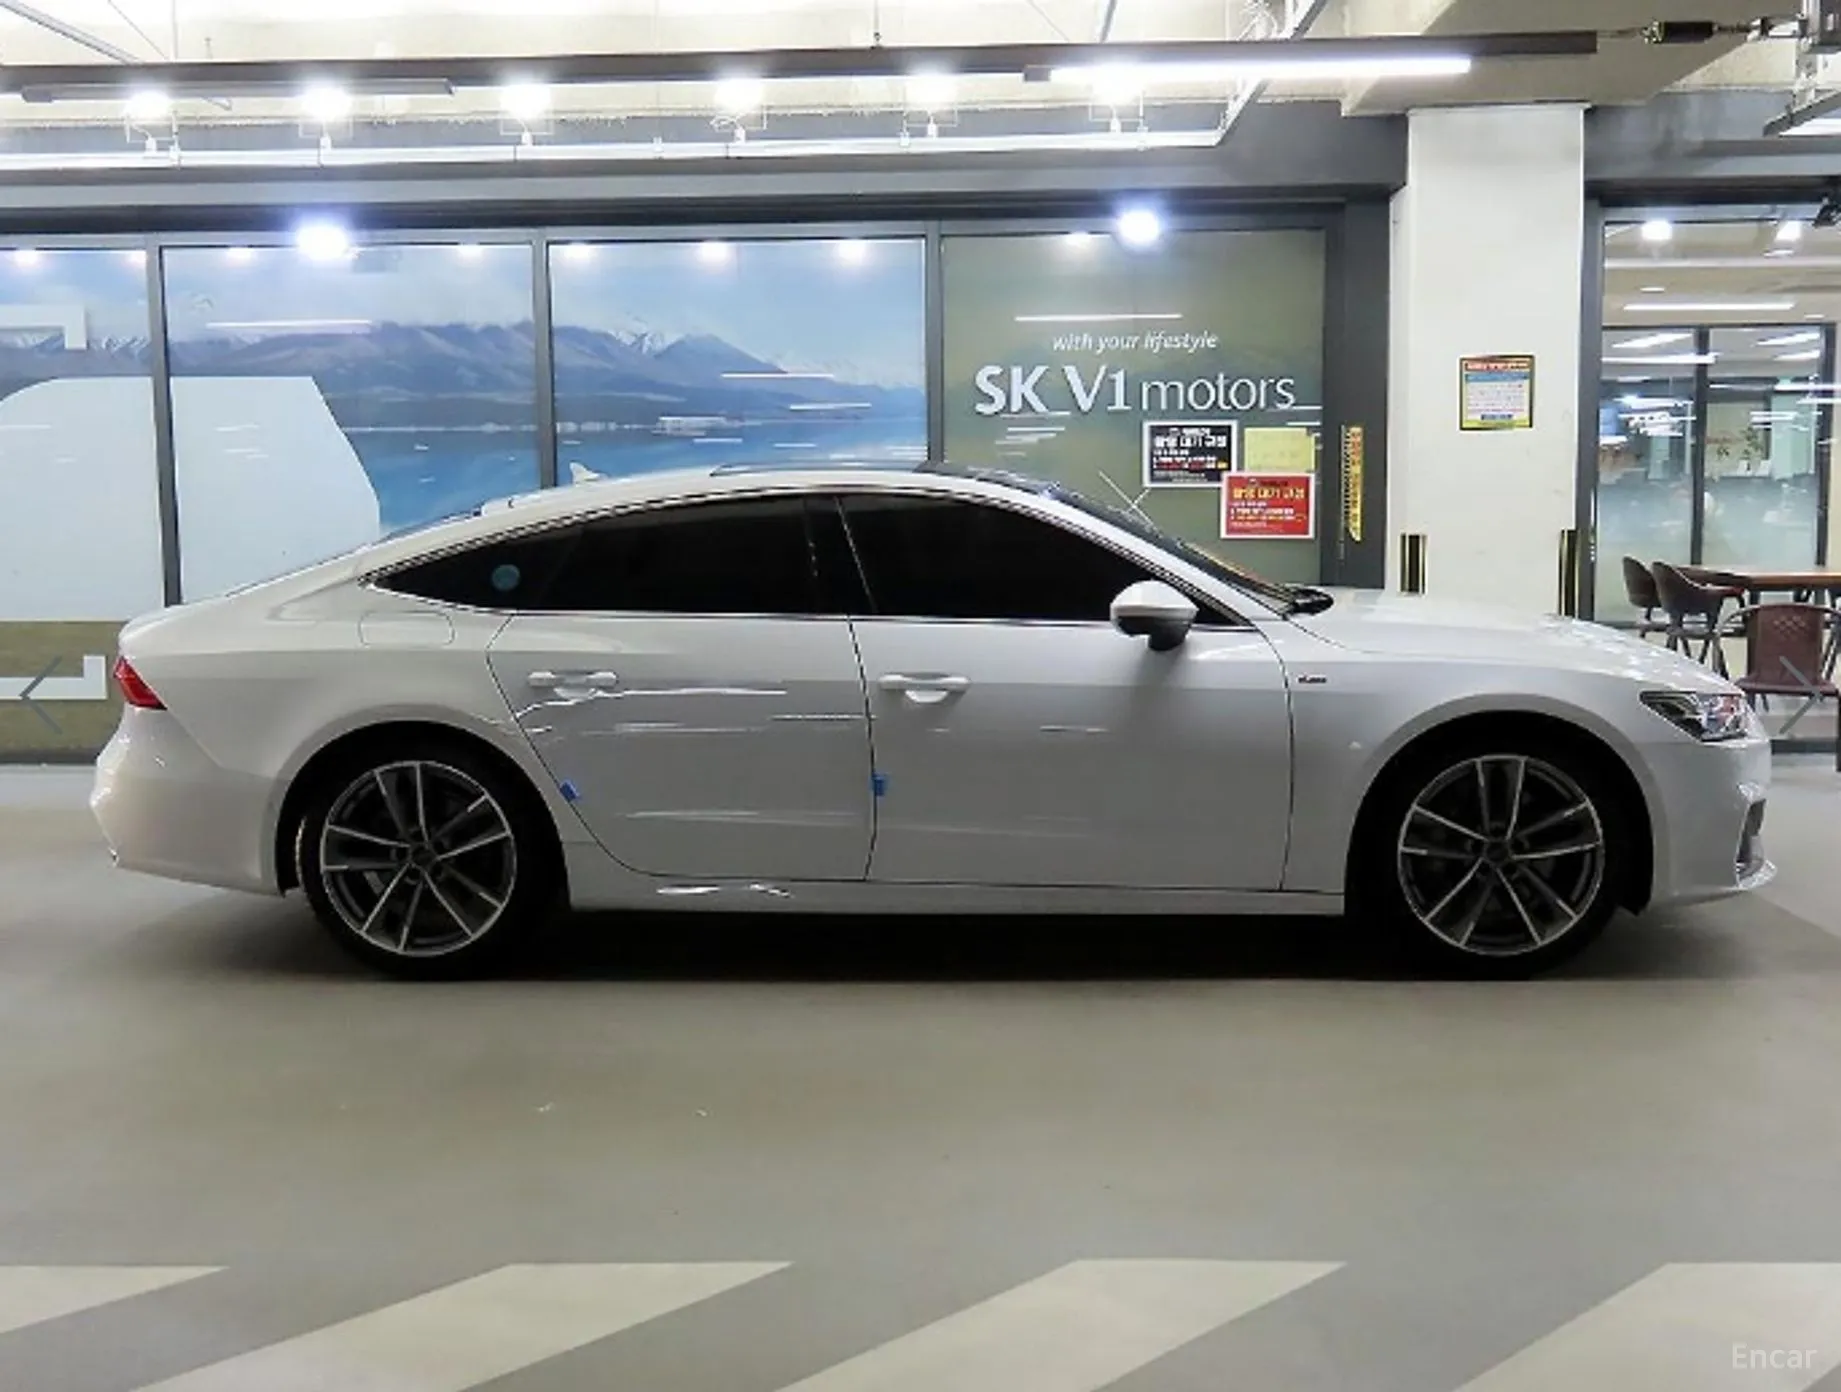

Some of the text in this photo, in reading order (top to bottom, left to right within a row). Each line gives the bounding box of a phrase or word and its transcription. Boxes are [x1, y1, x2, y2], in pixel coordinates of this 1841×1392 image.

[1052, 330, 1219, 355] with your lifestyle
[974, 364, 1296, 415] SK V1 motors
